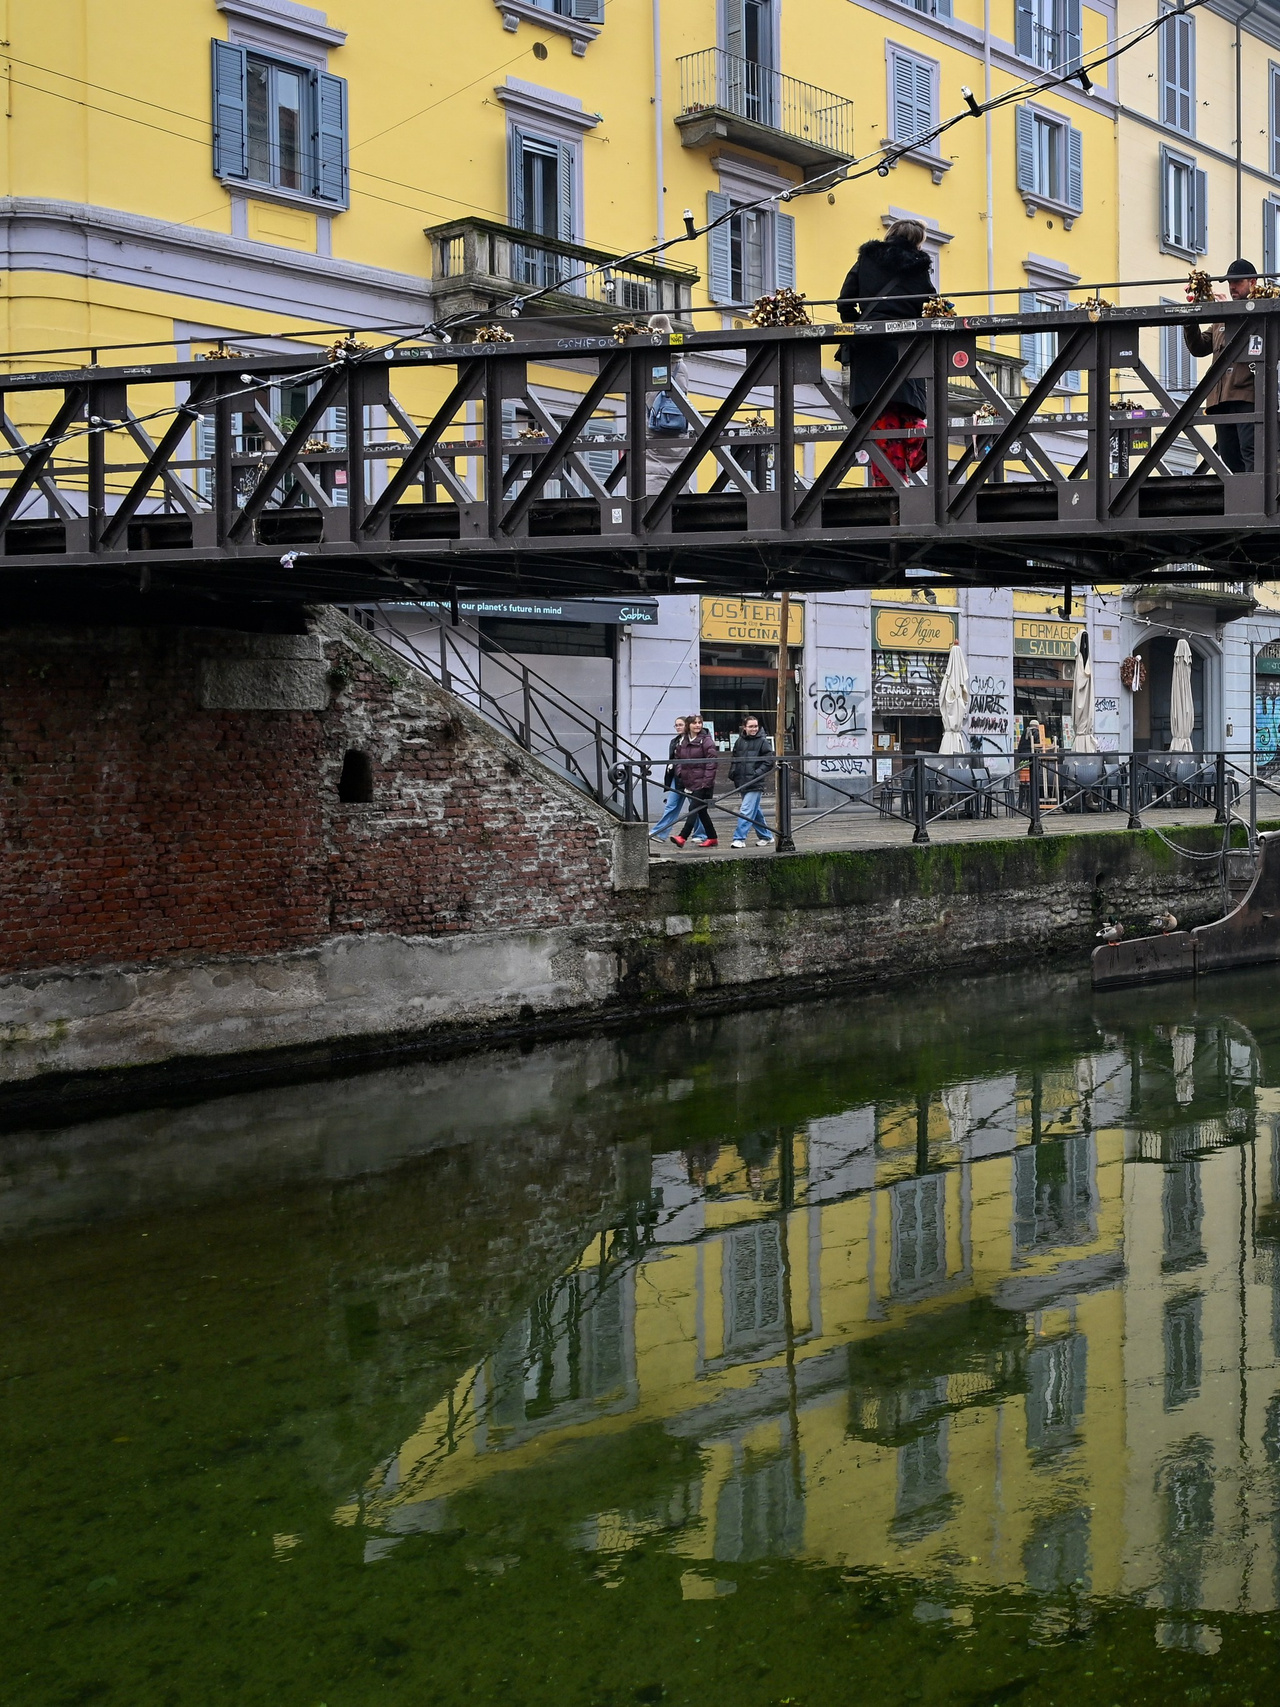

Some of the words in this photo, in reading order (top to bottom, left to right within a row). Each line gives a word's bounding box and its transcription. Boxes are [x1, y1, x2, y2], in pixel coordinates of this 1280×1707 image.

[461, 602, 476, 610] our
[477, 602, 508, 612] planet's
[509, 603, 533, 613] future
[534, 605, 542, 613] in
[543, 606, 562, 615] mind
[618, 607, 652, 622] Sabbia
[728, 627, 780, 640] CUCINA
[890, 617, 911, 637] Le
[909, 617, 940, 645] Vigne
[1021, 622, 1079, 640] FORMAGGI
[1029, 641, 1072, 656] SALUMI
[912, 697, 940, 709] CLOSE
